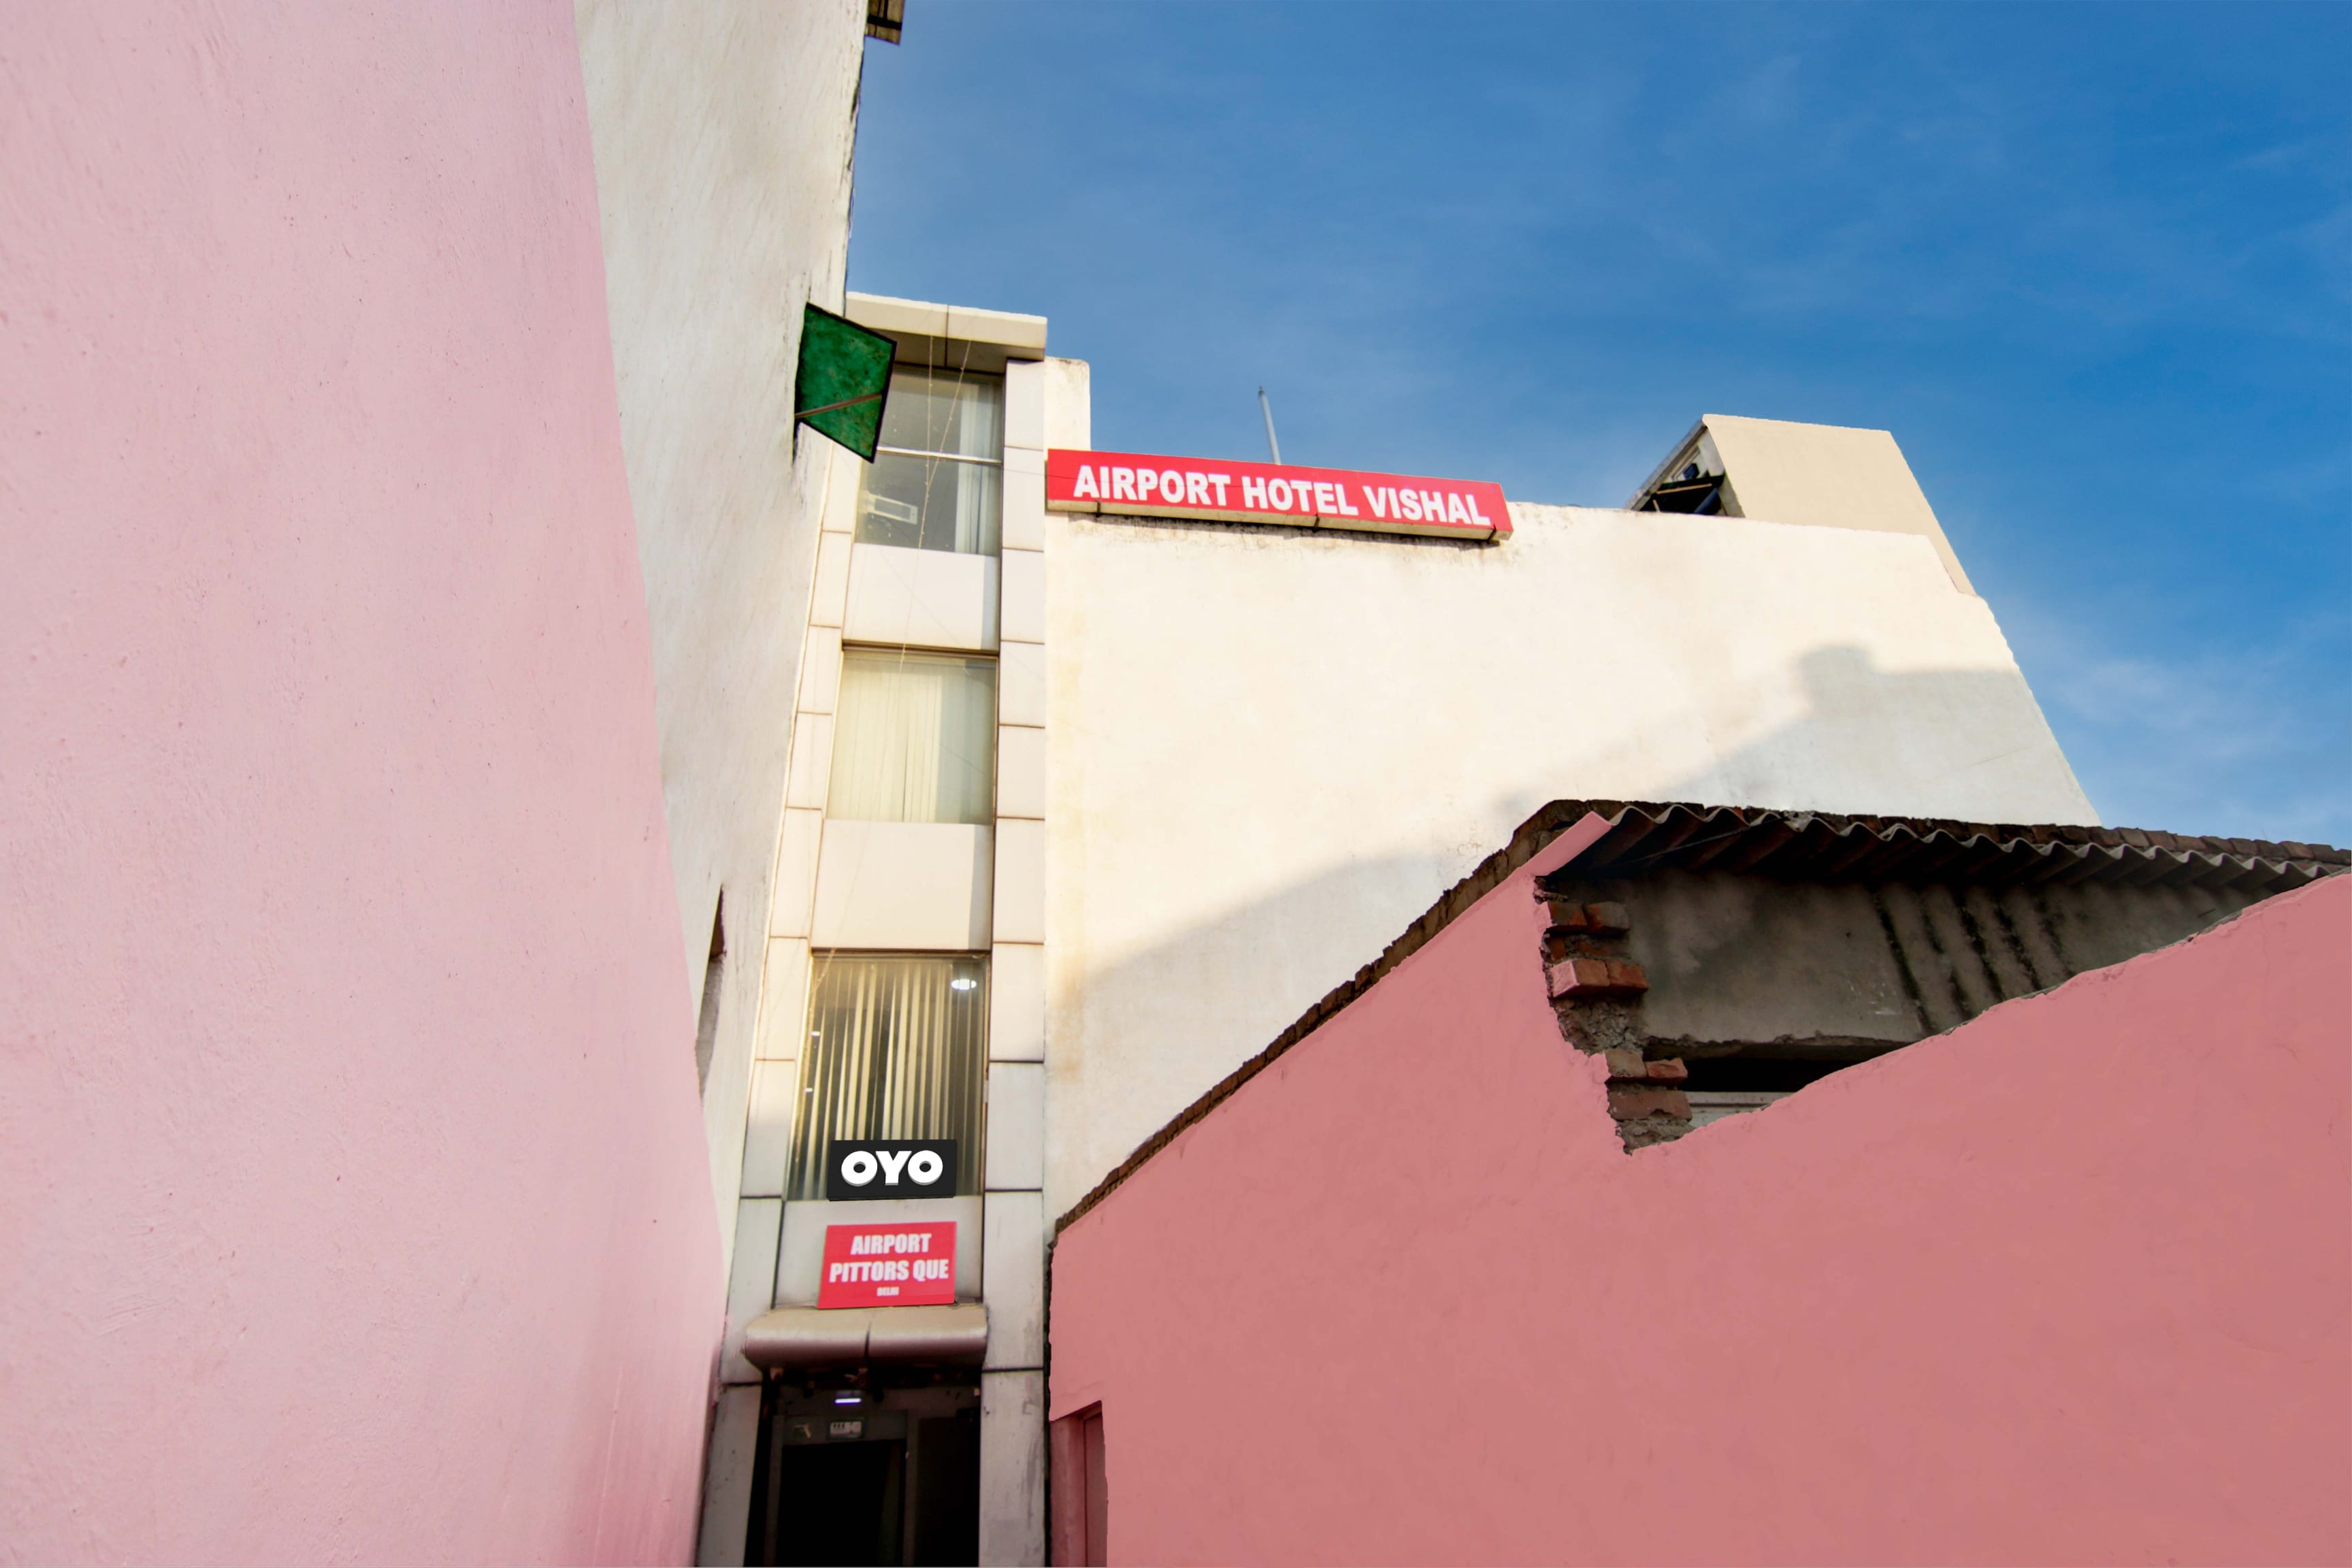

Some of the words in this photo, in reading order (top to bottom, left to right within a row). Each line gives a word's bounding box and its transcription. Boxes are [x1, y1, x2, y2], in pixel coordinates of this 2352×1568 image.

[1074, 465, 1230, 507] AIRPORT
[1242, 478, 1359, 517] HOTEL
[1362, 485, 1491, 526] VISHAL
[840, 1149, 943, 1186] OYO
[850, 1233, 932, 1255] AIRPORT
[829, 1260, 909, 1283] PITTORS
[913, 1259, 949, 1281] QUE
